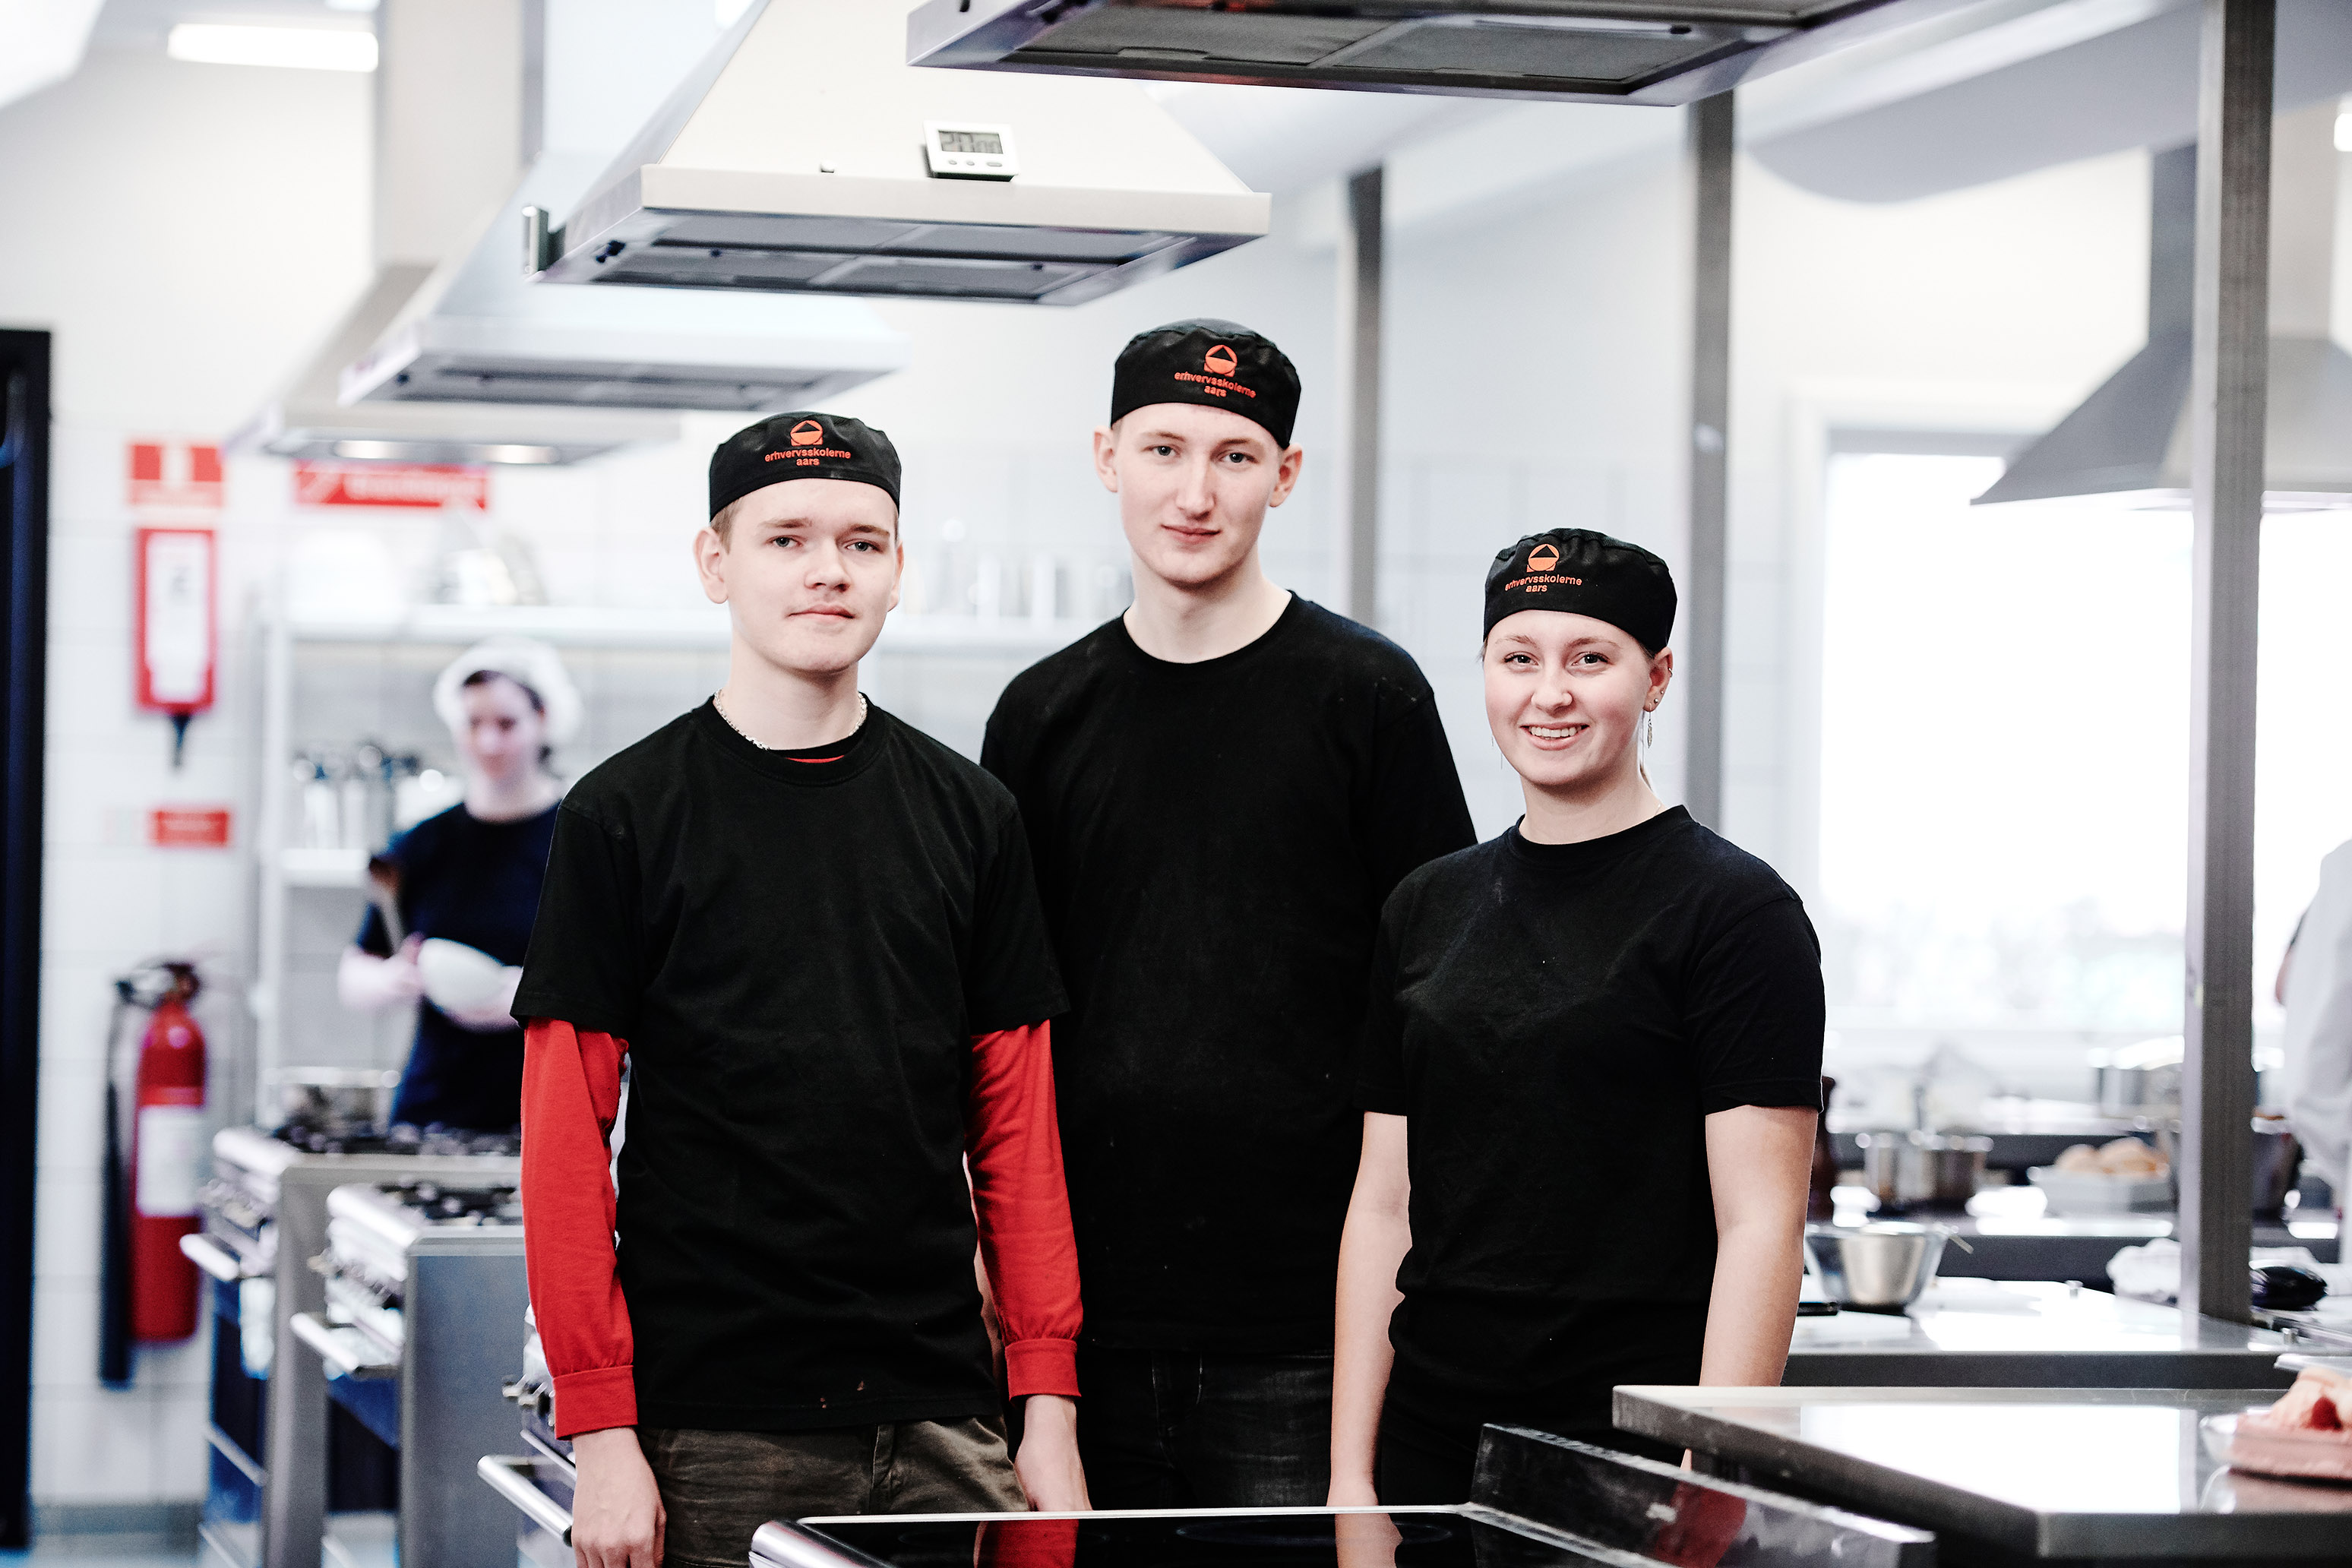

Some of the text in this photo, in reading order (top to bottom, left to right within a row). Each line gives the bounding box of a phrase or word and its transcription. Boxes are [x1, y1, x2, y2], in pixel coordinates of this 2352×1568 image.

[1174, 371, 1257, 398] erhvervsskolerne
[1203, 385, 1227, 397] aars
[764, 447, 852, 462] erhvervsskolerne
[795, 457, 820, 466] aars
[1504, 574, 1582, 591] erhvervsskolerne
[1525, 584, 1547, 593] aars
